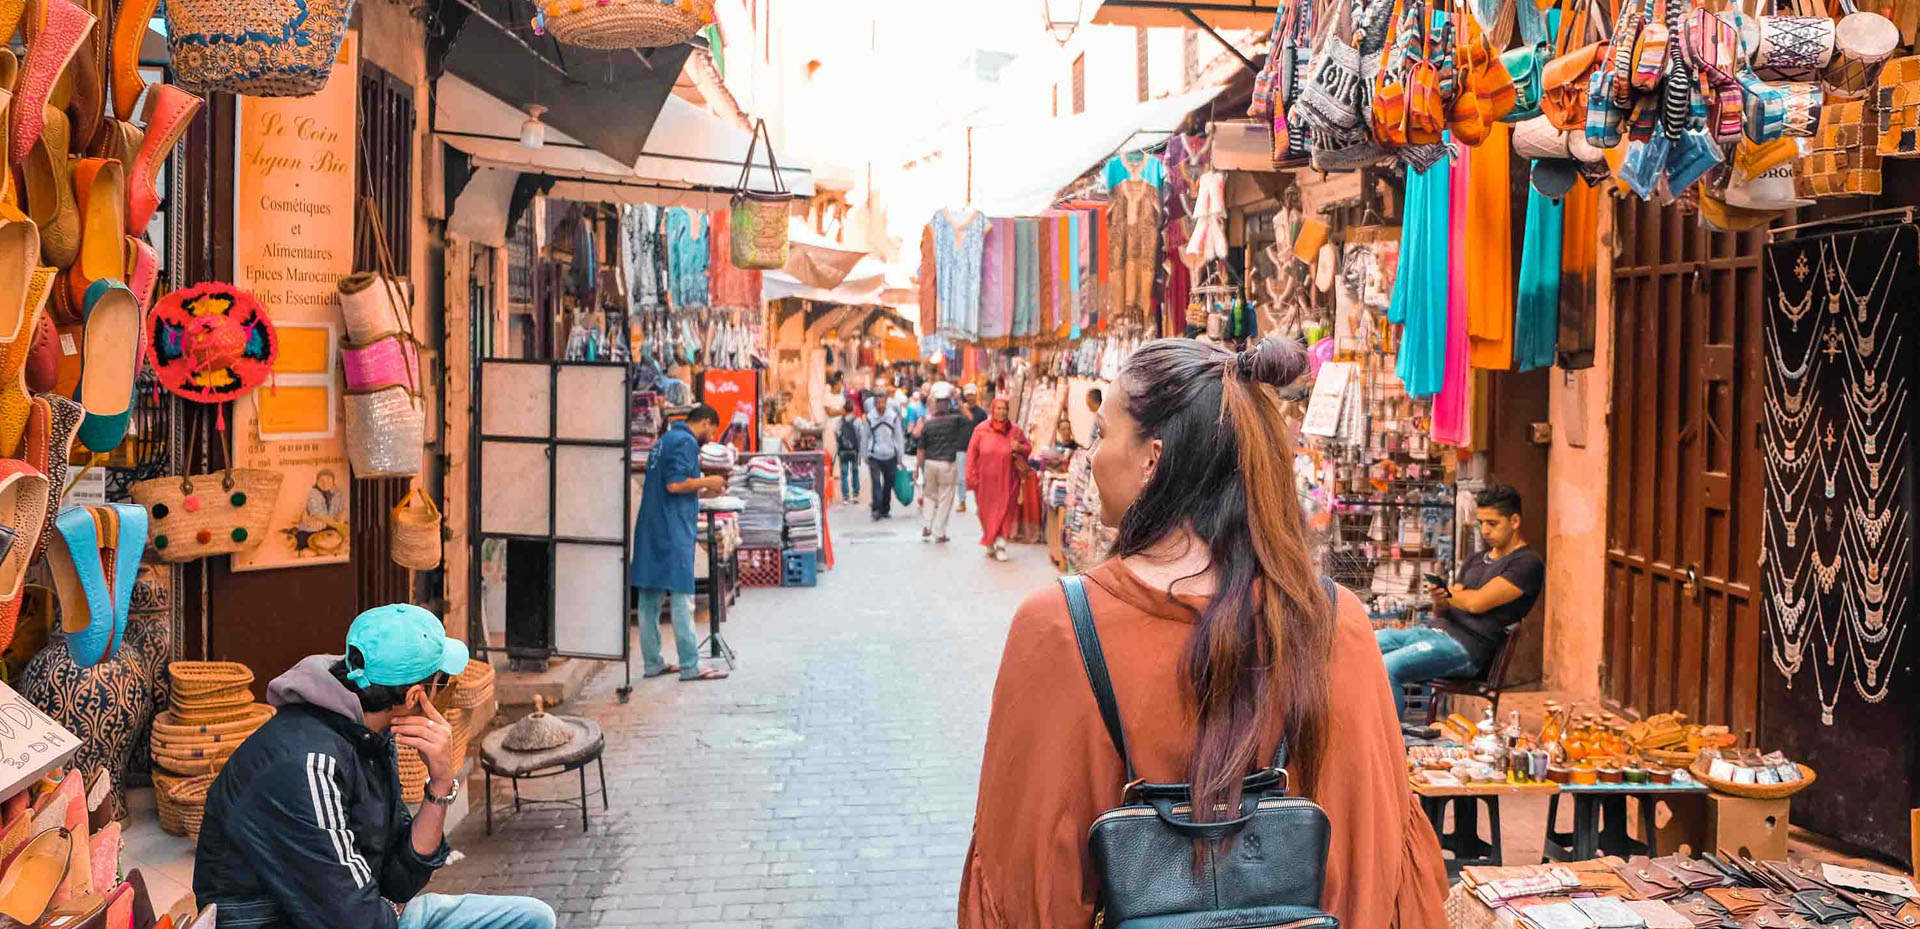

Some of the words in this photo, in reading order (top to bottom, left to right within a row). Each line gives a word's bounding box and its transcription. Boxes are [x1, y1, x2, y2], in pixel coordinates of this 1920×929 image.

[261, 111, 284, 137] Le
[293, 115, 339, 144] Coin
[310, 150, 349, 172] Bio
[260, 196, 331, 217] Cosmétiques
[290, 223, 302, 236] et
[262, 242, 333, 261] Alimentaires
[245, 264, 283, 284] Epices
[286, 267, 343, 283] Marocaine
[286, 289, 342, 307] Essentielle
